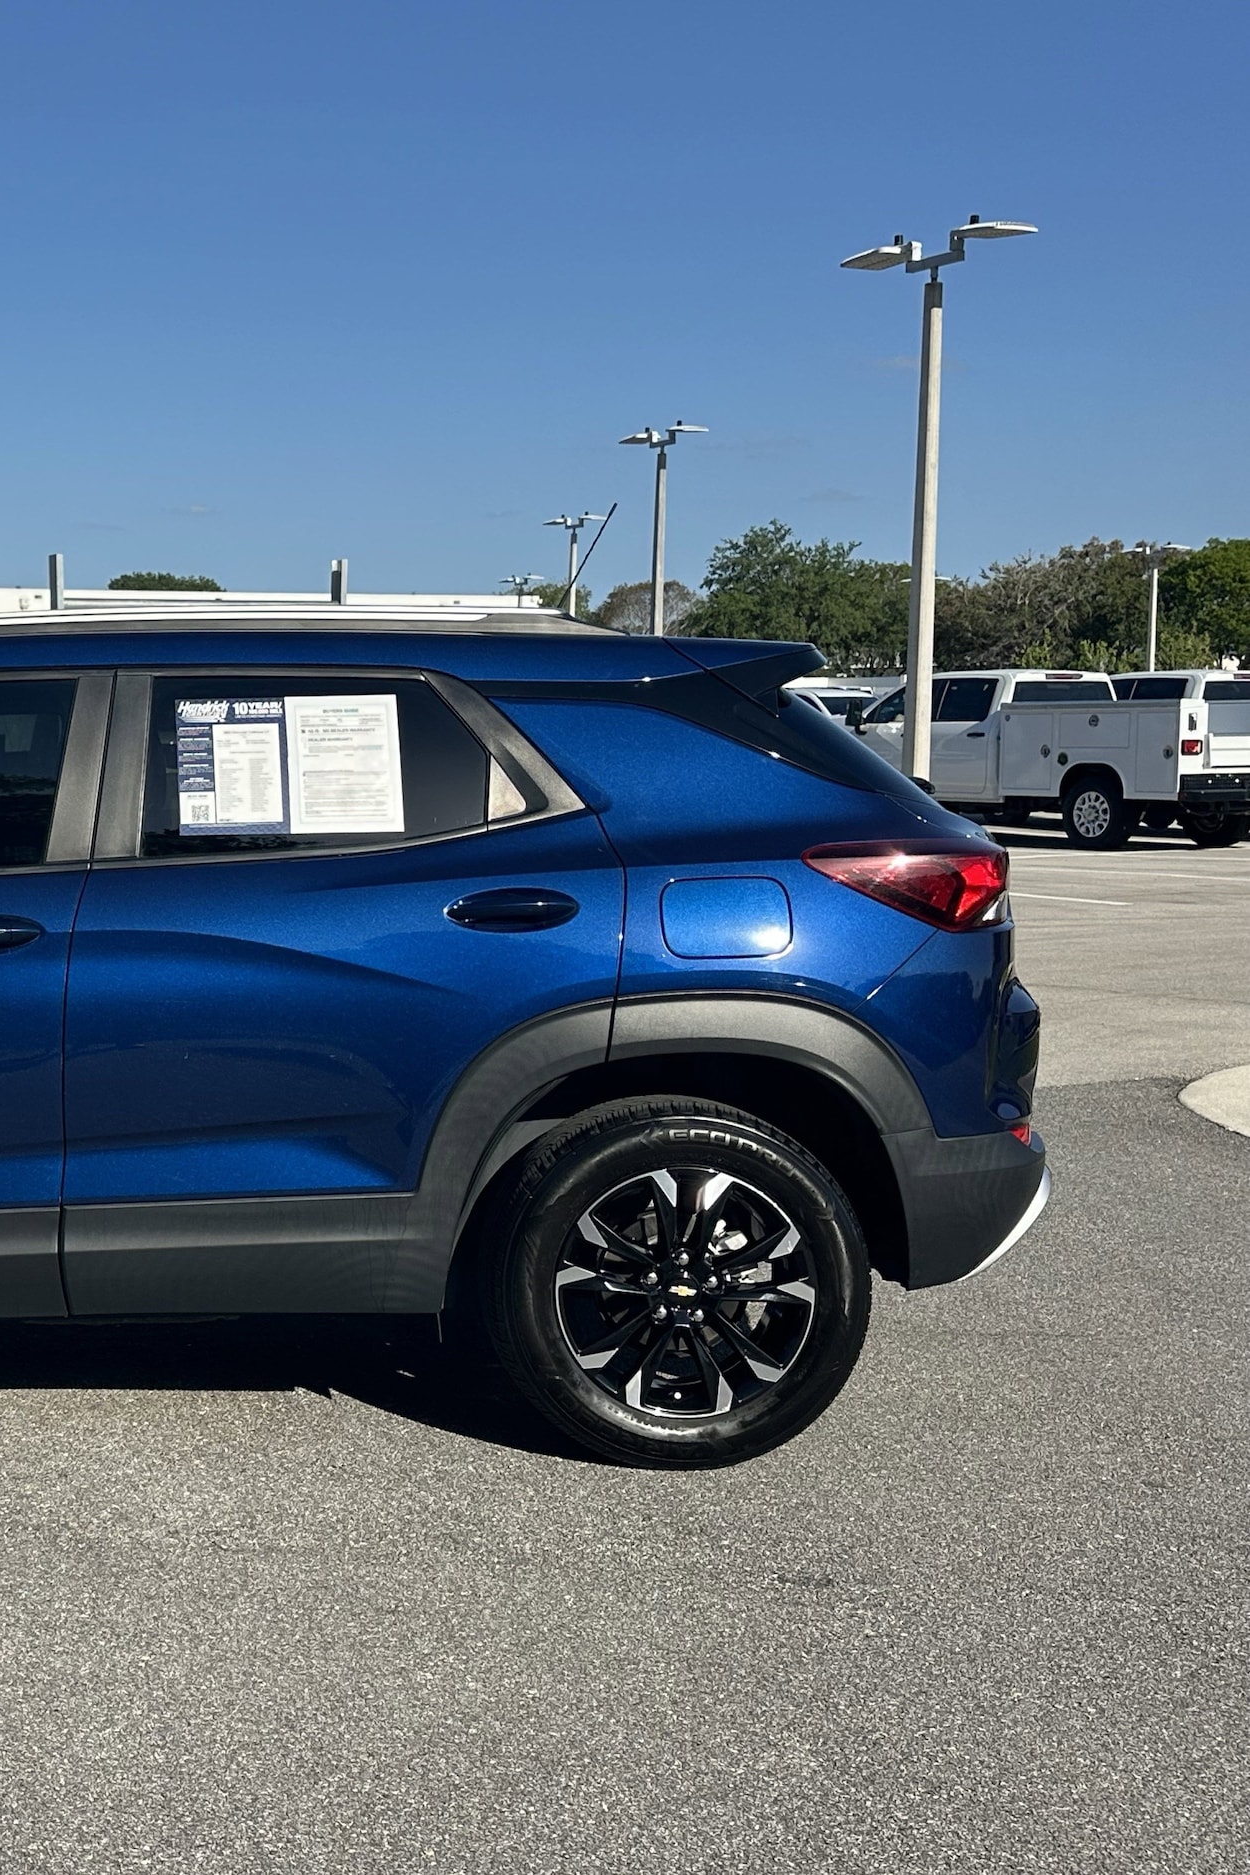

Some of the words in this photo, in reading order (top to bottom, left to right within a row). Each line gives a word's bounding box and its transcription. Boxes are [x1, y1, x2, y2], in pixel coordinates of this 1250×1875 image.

[177, 700, 230, 718] Hendrick
[232, 701, 248, 715] 10
[668, 1129, 731, 1148] ECO
